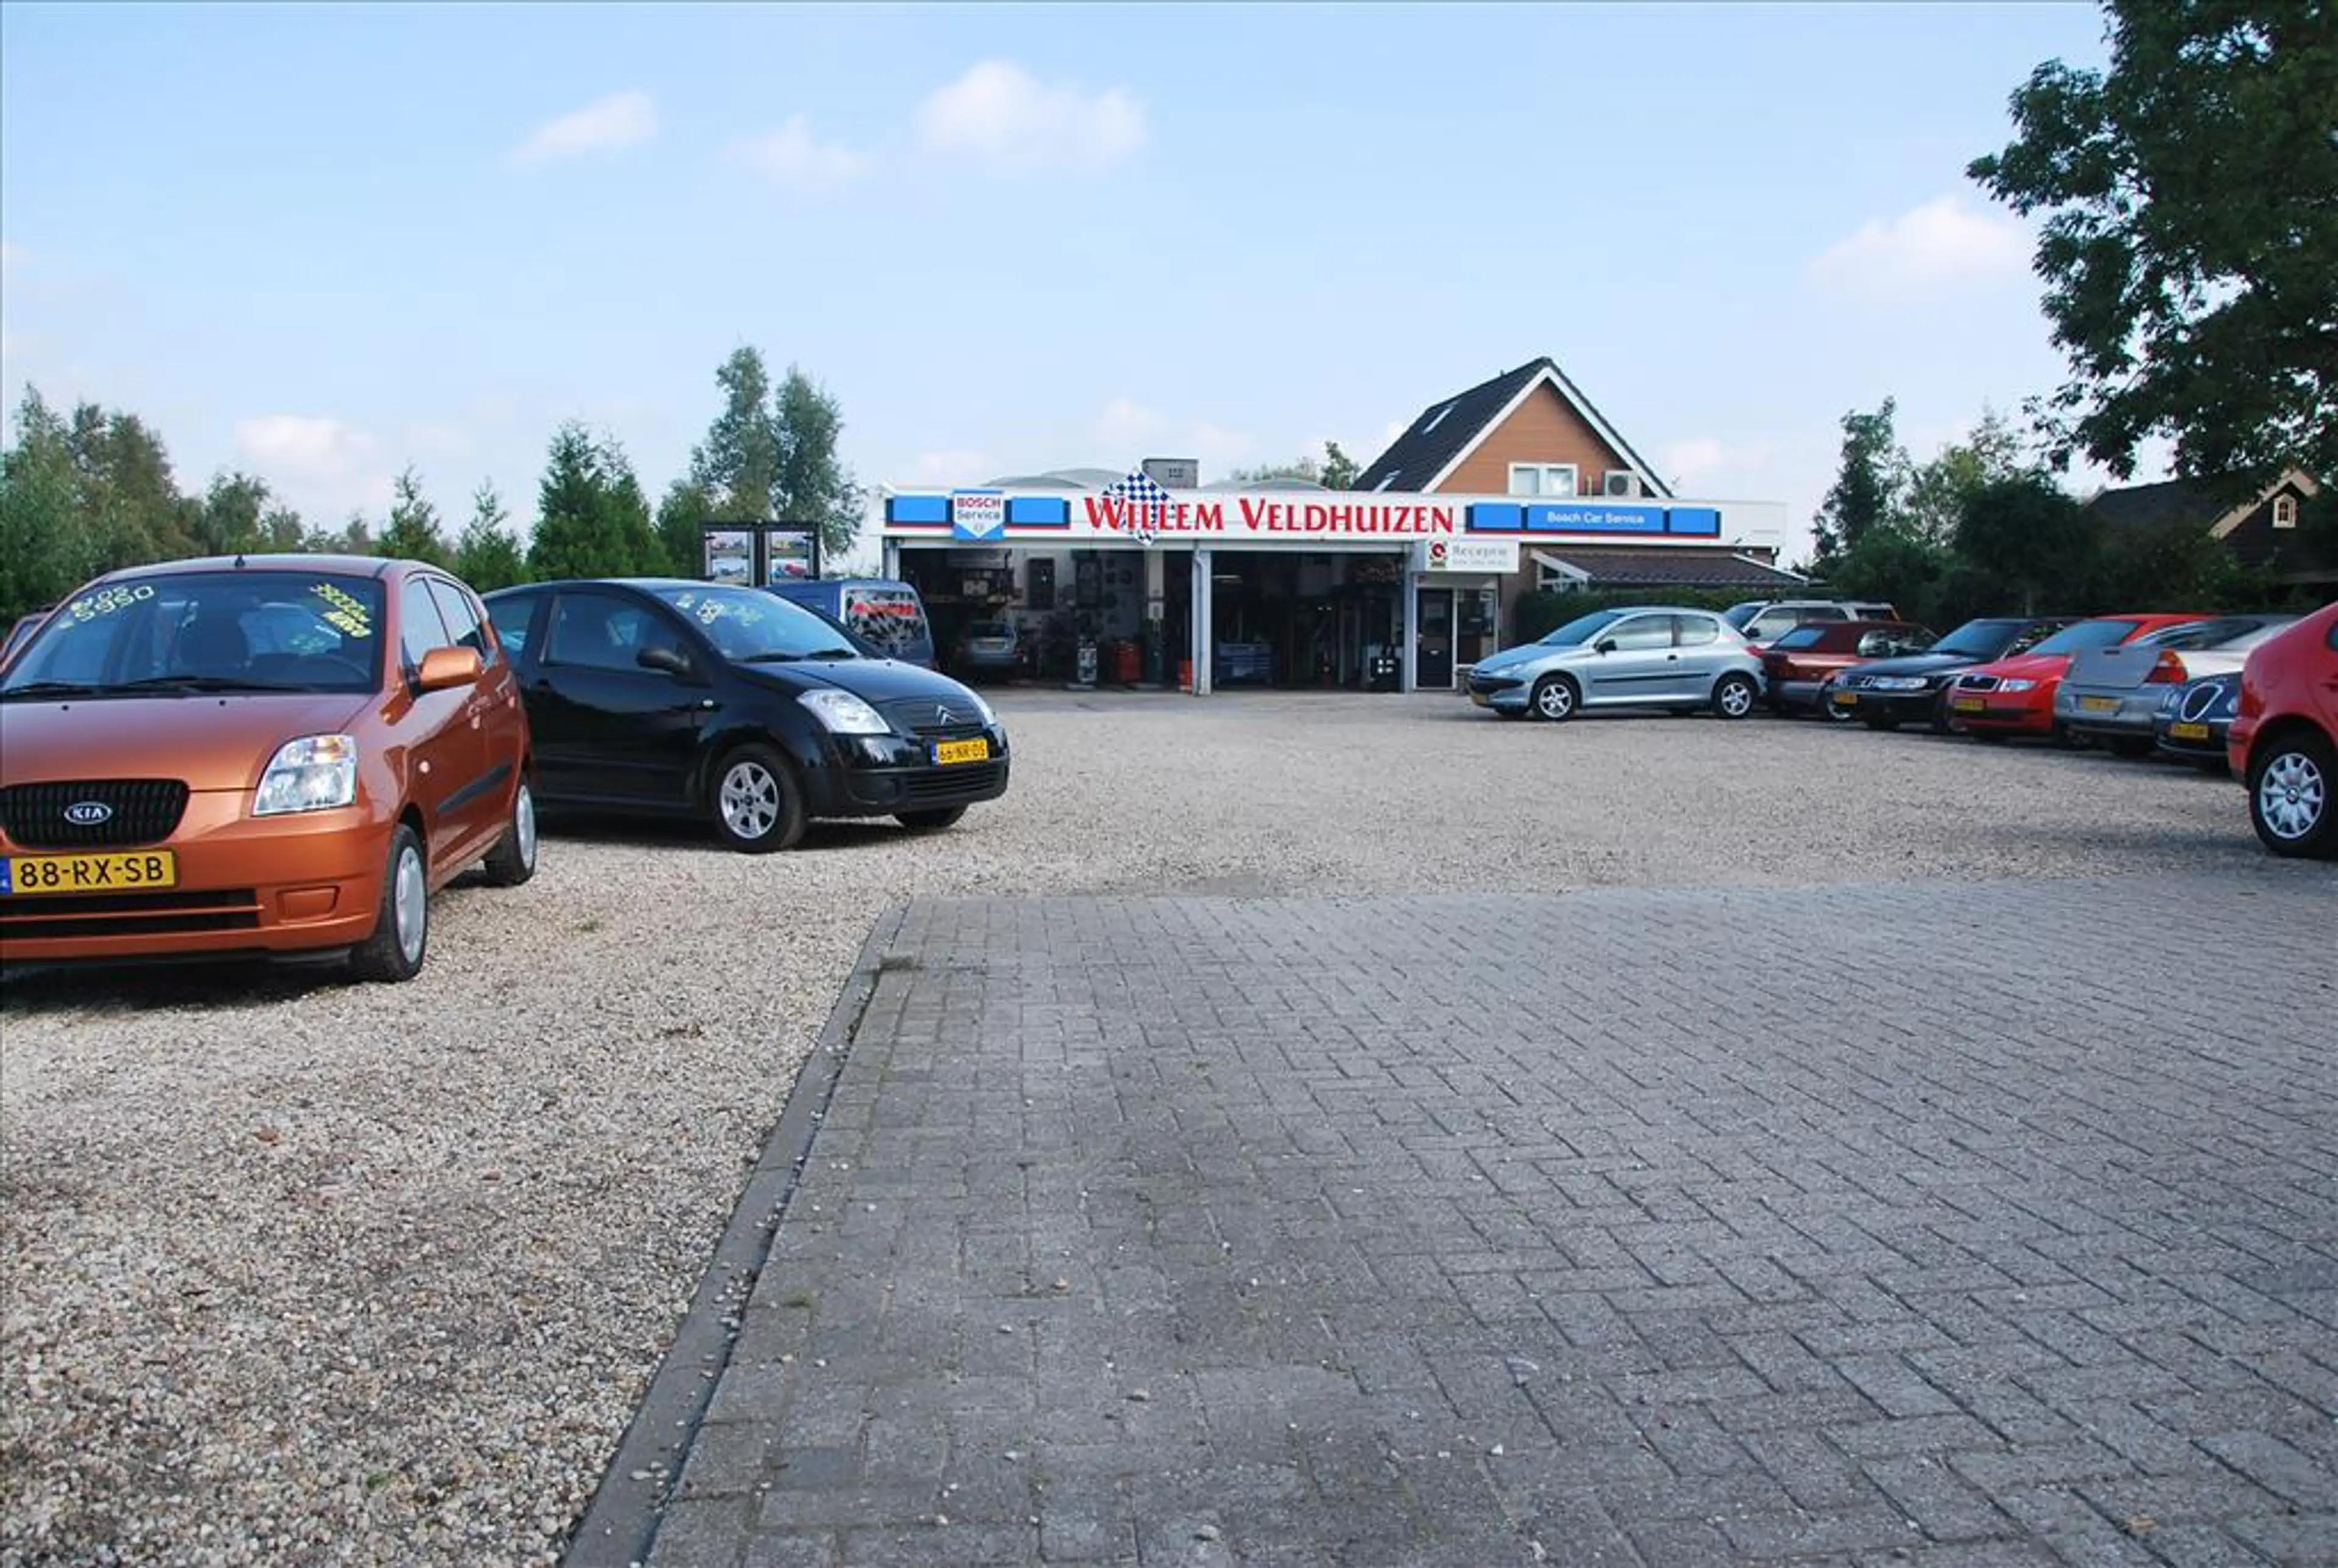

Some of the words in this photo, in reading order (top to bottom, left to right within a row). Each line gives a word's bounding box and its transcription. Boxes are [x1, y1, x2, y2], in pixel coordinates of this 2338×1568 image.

[957, 497, 1001, 508] BOSCH
[957, 509, 1000, 520] Service
[1084, 497, 1224, 530] WILLEM
[1238, 498, 1453, 533] VELDHUIZEN
[1547, 511, 1581, 523] Bosch
[1584, 511, 1603, 523] Car
[1605, 513, 1645, 524] Service
[72, 807, 104, 819] KIA
[20, 856, 163, 887] 88-RX-SB
